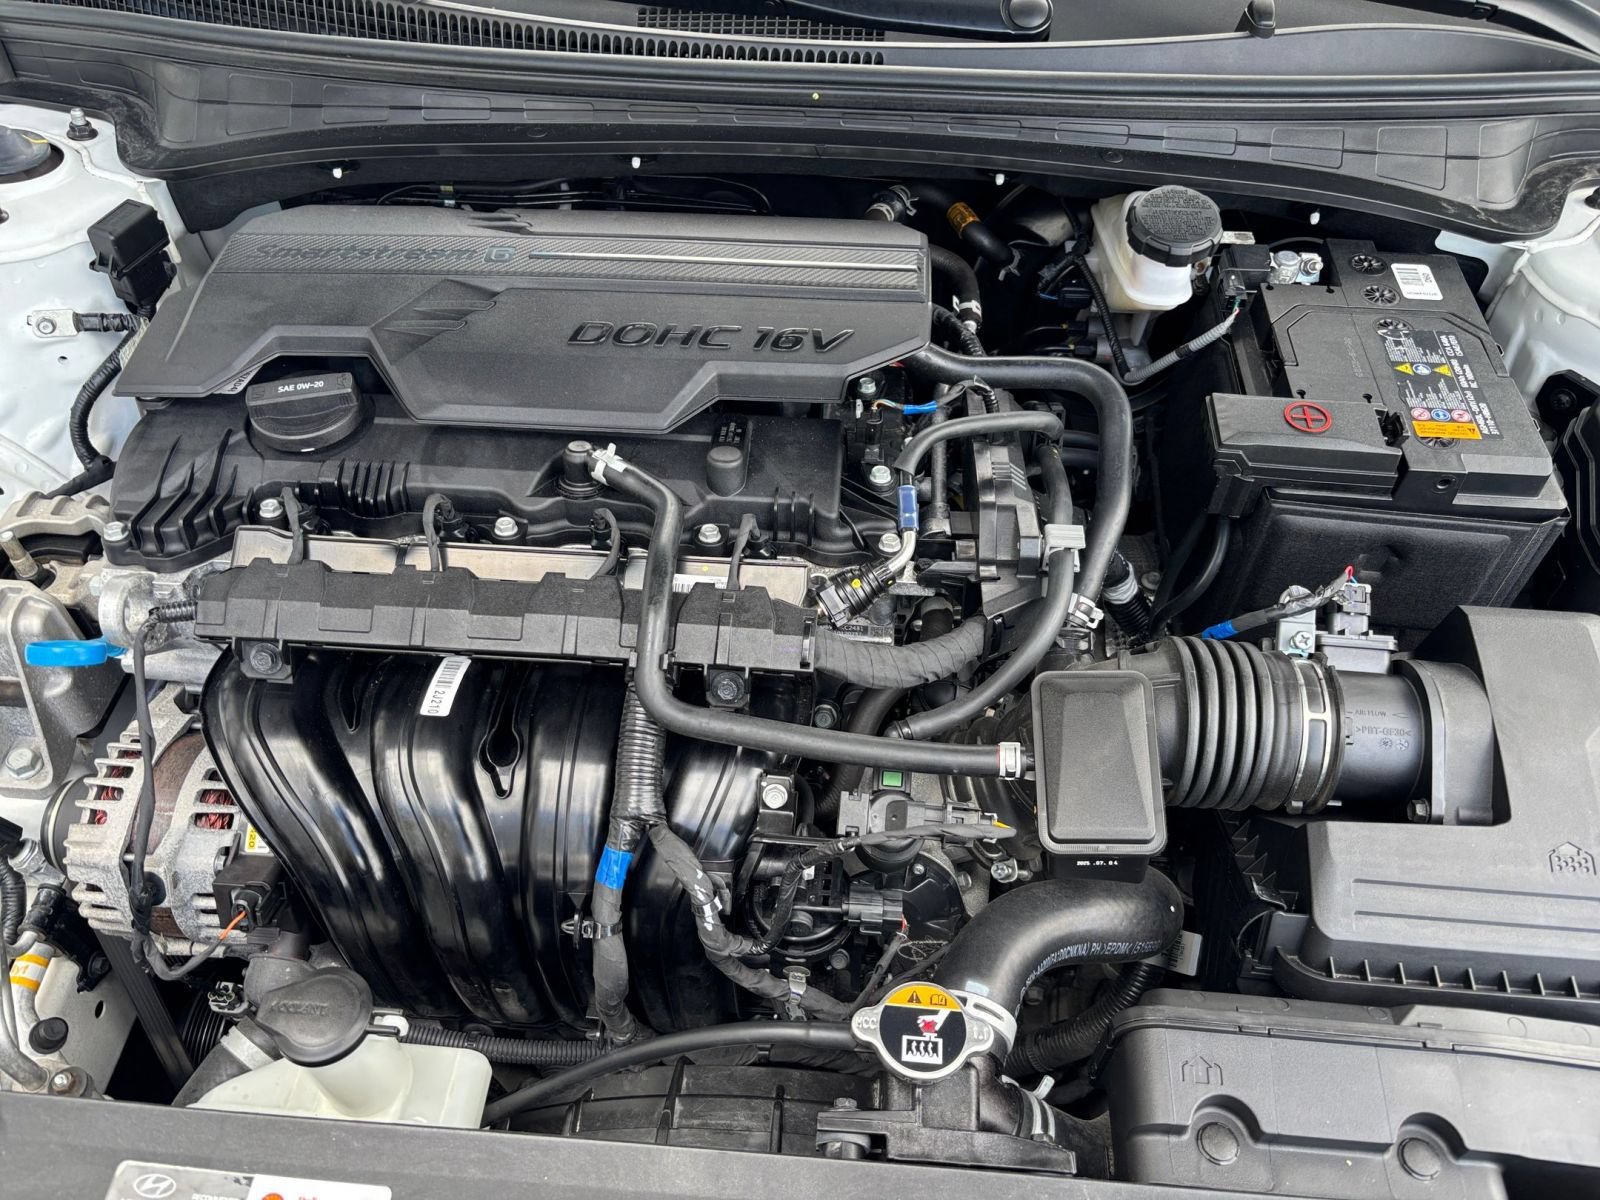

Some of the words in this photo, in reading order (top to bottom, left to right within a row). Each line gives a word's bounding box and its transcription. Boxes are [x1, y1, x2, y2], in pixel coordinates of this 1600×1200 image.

[567, 321, 742, 347] DOHC
[753, 326, 855, 353] 16V
[277, 384, 295, 393] SAE
[296, 380, 324, 390] 0W-20
[427, 690, 446, 714] 2J210
